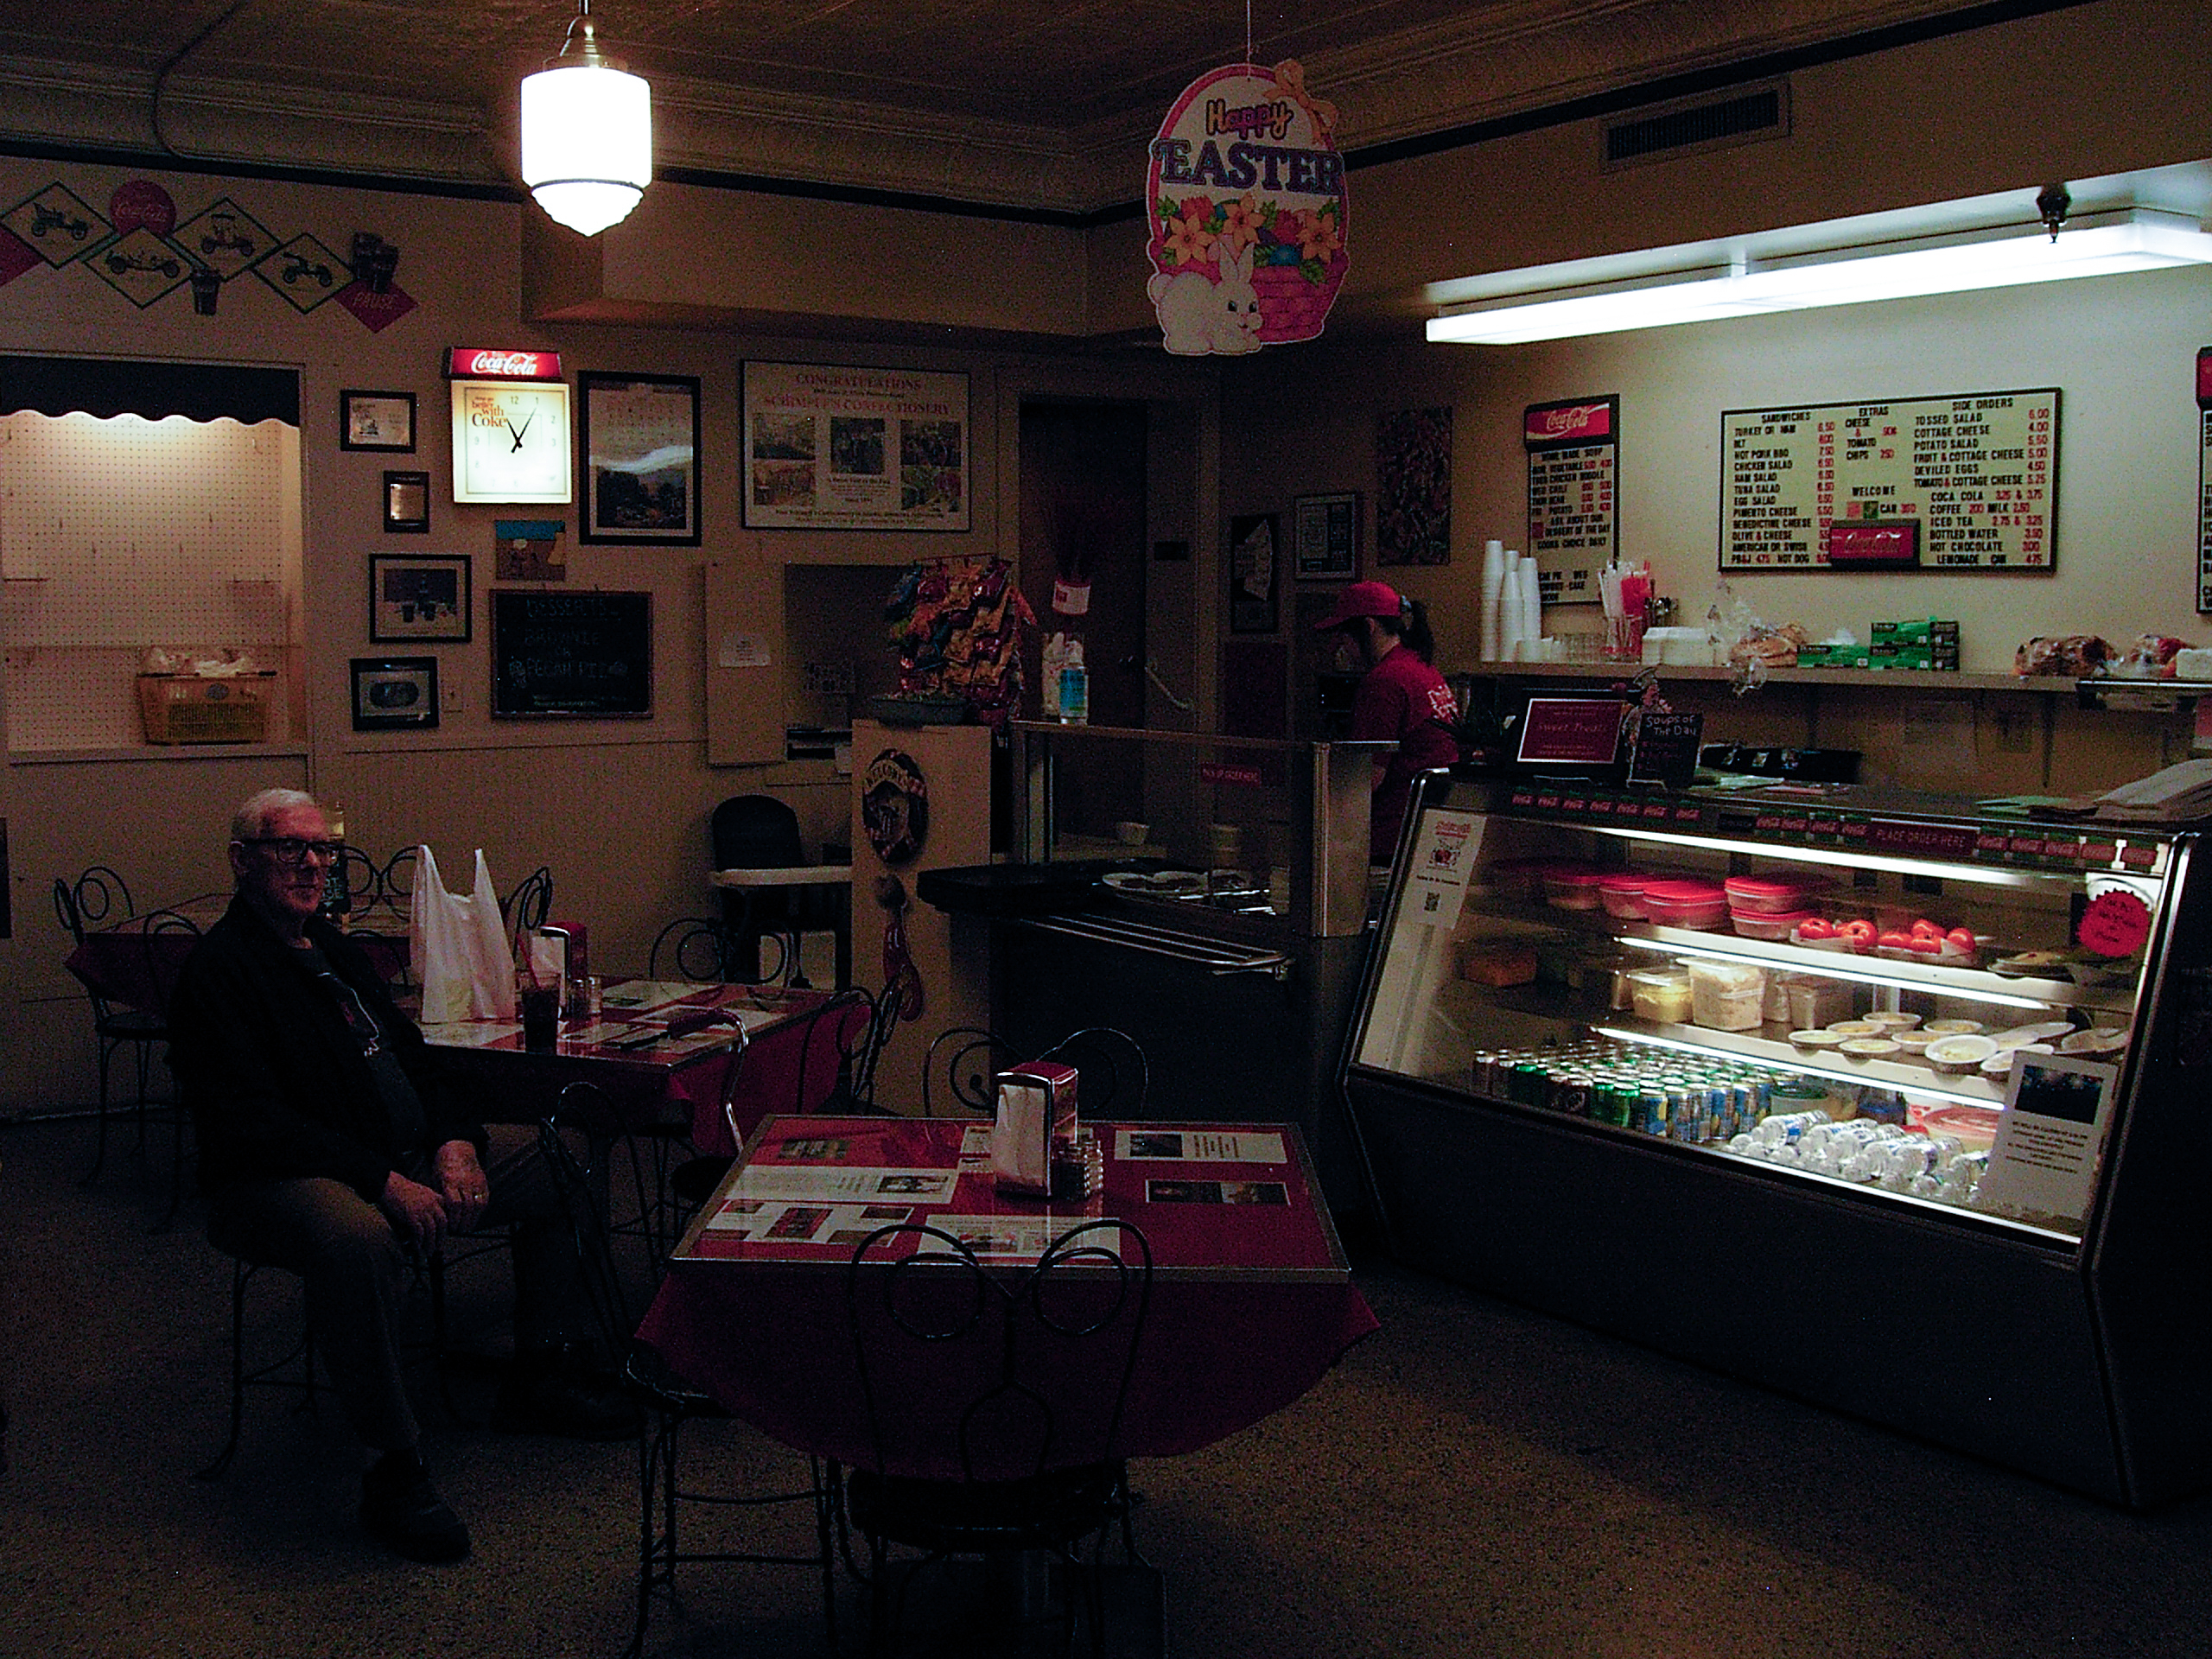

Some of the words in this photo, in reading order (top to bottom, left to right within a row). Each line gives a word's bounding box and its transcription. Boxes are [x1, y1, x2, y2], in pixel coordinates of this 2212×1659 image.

[1206, 99, 1294, 139] Happy
[1152, 138, 1344, 196] EASTER
[471, 351, 537, 376] Coca-Cola
[1952, 399, 1972, 410] SIDE
[1976, 397, 2013, 409] ORDERS
[482, 404, 505, 416] with
[1859, 407, 1889, 417] EXTRAS
[472, 413, 505, 428] Coke
[1547, 407, 1589, 432] Coca-Cola
[1762, 412, 1811, 423] SANDWICHES
[1845, 418, 1871, 428] CHEESE
[1916, 414, 1948, 425] TOSSED
[1954, 412, 1982, 423] SALAD
[1735, 426, 1762, 437] TURKEY
[1764, 425, 1775, 435] OR
[1914, 426, 1953, 438] COTTAGE
[1956, 424, 1990, 435] CHEESE
[2028, 421, 2049, 432] 4.00
[1847, 437, 1876, 448] TOMATO
[1914, 439, 1947, 450] POTATO
[1950, 438, 1979, 448] SALAD
[1734, 450, 1749, 460] HOT
[1847, 449, 1869, 460] CHIPS
[1914, 452, 1938, 463] FRUIT
[1941, 452, 1947, 461] &
[1949, 450, 1987, 461] COTTAGE
[1991, 448, 2024, 460] CHEESE
[1734, 460, 1765, 470] CHICKEN
[1769, 460, 1792, 469] SALAD
[1915, 465, 1950, 476] DEVILED
[1955, 464, 1979, 474] EGGS
[1734, 474, 1751, 483] HAM
[1753, 472, 1777, 482] SALAD
[1914, 478, 1943, 488] TOMATO
[1944, 477, 1950, 487] &
[1952, 476, 1987, 487] COTTAGE
[1991, 474, 2023, 485] CHEESE
[1734, 485, 1752, 494] TUNA
[1756, 484, 1780, 493] SALAD
[1852, 486, 1896, 497] WELCOME
[1733, 497, 1747, 505] EGG
[1752, 495, 1776, 505] SALAD
[1931, 492, 1955, 501] COCA
[1961, 491, 1983, 501] COLA
[2015, 489, 2022, 499] &
[1733, 508, 1766, 518] PIMENTO
[1769, 506, 1797, 517] CHEESE
[1880, 504, 1897, 513] CAN
[1930, 503, 1961, 514] COFFEE
[1987, 502, 2009, 512] MILK
[1733, 519, 1779, 530] BENEDICTINE
[1783, 518, 1811, 528] CHEESE
[1930, 517, 1952, 526] ICED
[1957, 516, 1973, 525] TEA
[1732, 531, 1752, 541] OLIVE
[1764, 530, 1792, 539] CHEESE
[1929, 529, 1965, 539] BOTTLED
[1967, 528, 1999, 538] WATER
[1732, 543, 1769, 553] AMERICAN
[1771, 543, 1780, 552] OR
[1783, 542, 1807, 552] SWISS
[1929, 542, 1946, 552] HOT
[1951, 541, 2003, 551] CHOCOLATE
[1777, 554, 1792, 563] HOT
[1795, 554, 1809, 563] DOG
[1937, 554, 1979, 564] LEMONADE
[1646, 716, 1680, 729] Soups
[1681, 715, 1695, 726] of
[1673, 726, 1697, 737] Day
[1876, 830, 1905, 842] PLACE
[1908, 832, 1938, 846] ORDER
[1941, 835, 1967, 849] HERE
